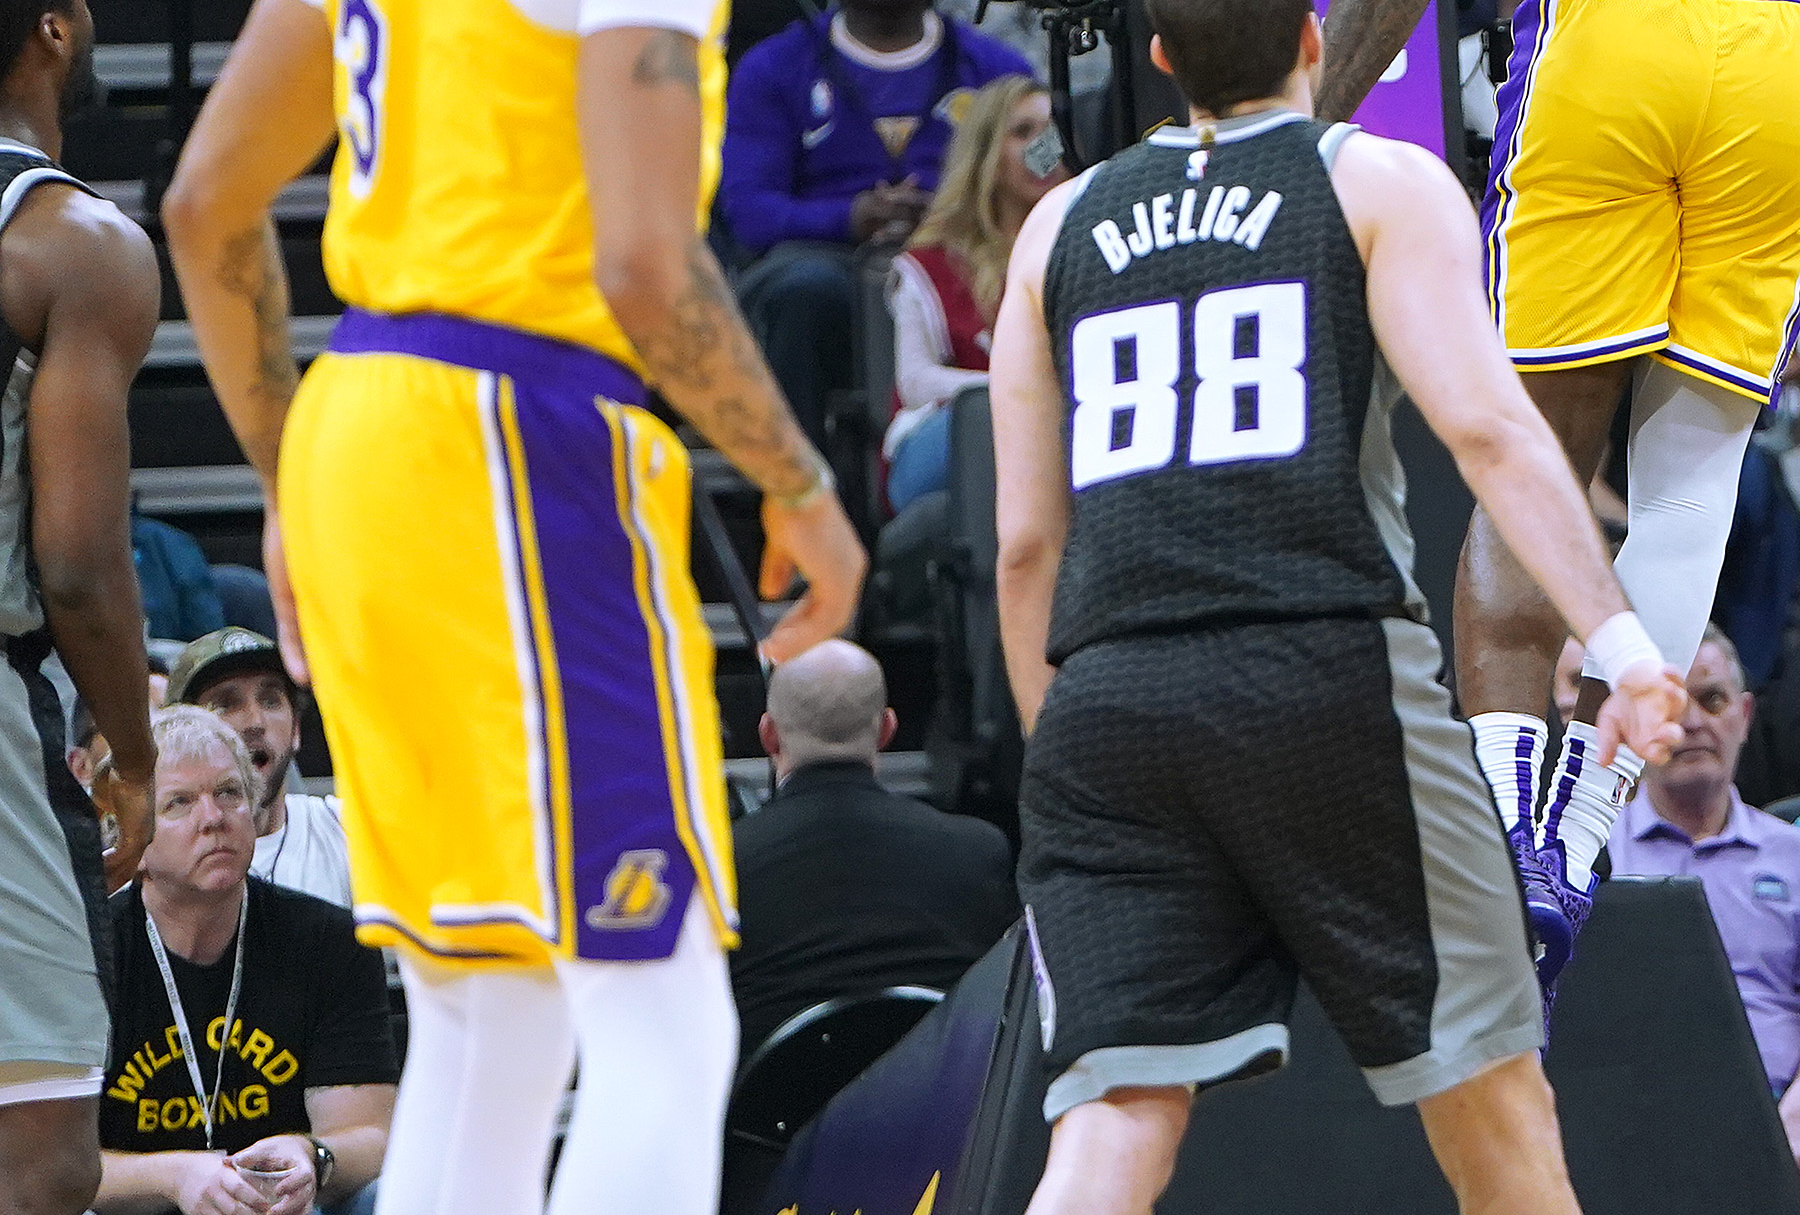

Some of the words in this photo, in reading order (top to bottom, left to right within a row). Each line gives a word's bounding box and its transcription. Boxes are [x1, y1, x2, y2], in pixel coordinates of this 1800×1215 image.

[1091, 184, 1283, 275] BJELICA
[1069, 280, 1307, 493] 88
[107, 1023, 185, 1104] WILD
[206, 1015, 299, 1086] CARD
